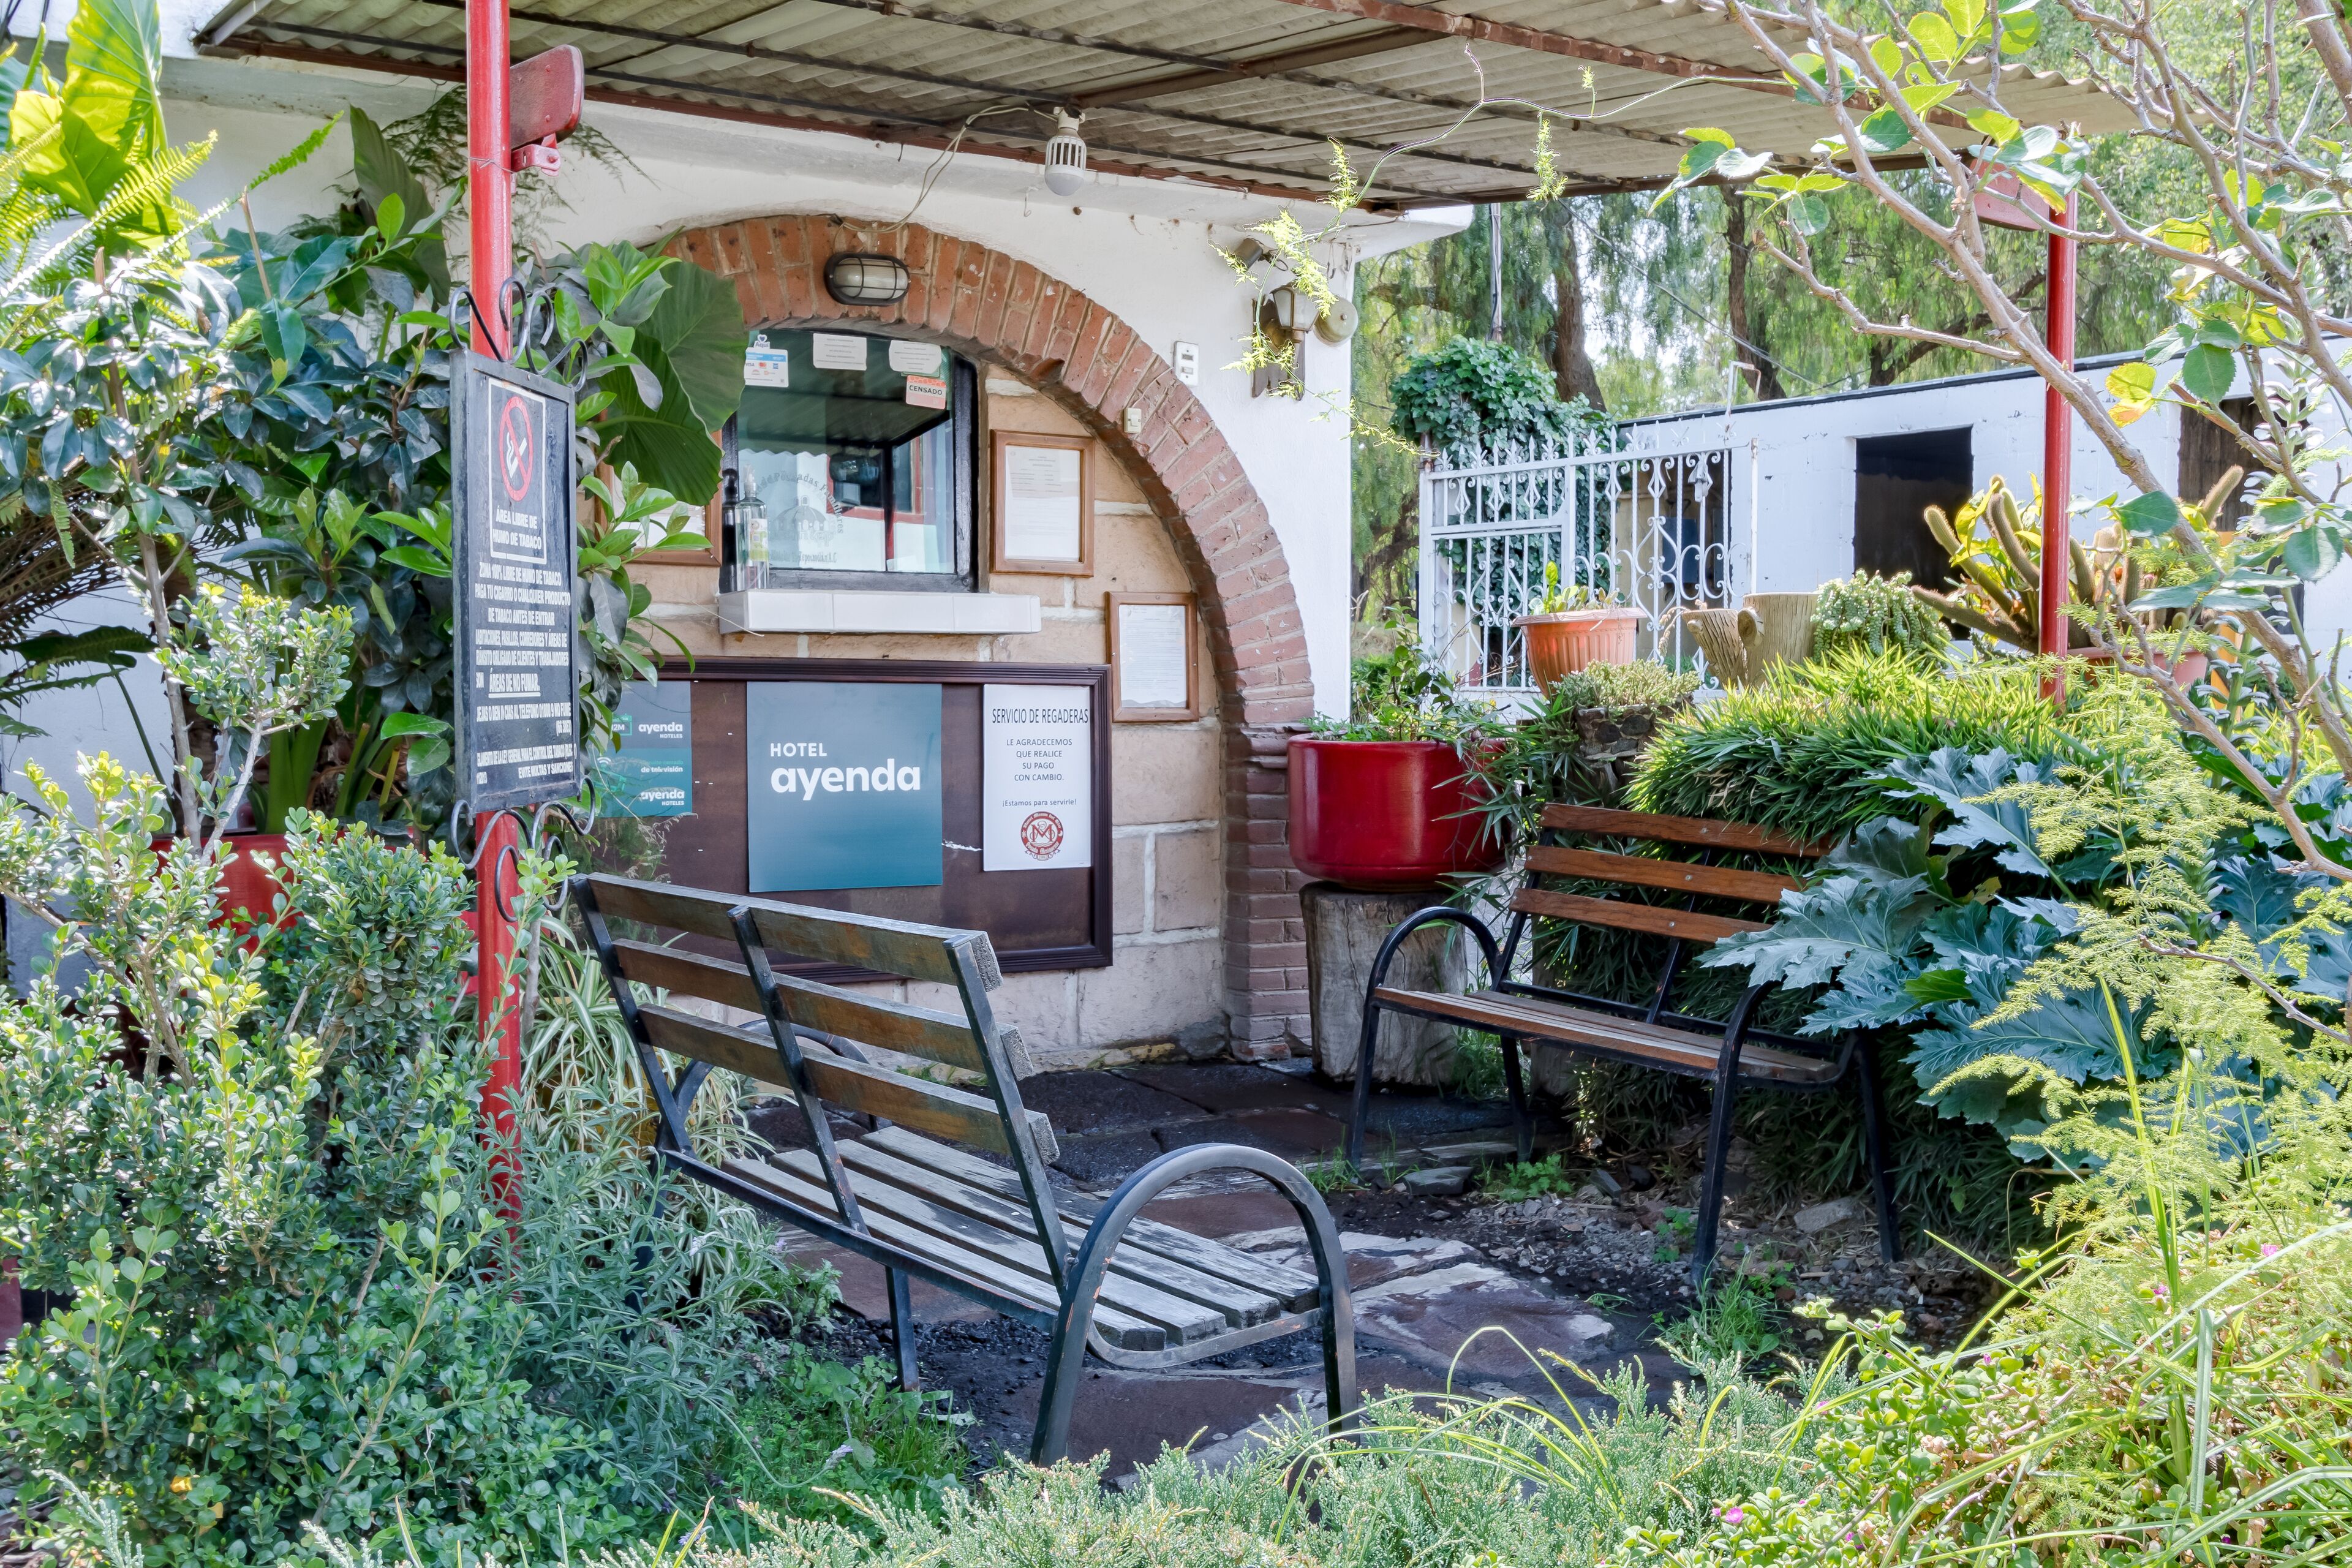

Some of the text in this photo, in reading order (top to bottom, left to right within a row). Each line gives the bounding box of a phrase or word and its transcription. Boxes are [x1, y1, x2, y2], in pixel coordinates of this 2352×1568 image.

[909, 385, 943, 395] CENSADO
[496, 505, 538, 529] ÁREA LIBRE DE
[492, 529, 542, 549] HUMO DE TABACO
[479, 562, 562, 586] ZONA 100% LIBRE DE HUMO DE TABACO
[487, 584, 493, 599] TU
[494, 586, 513, 601] CIGARRO
[513, 587, 518, 601] O
[518, 588, 544, 604] CUALQUIER
[545, 590, 571, 606] PRODUCTO
[488, 608, 555, 626] DE TABACO ANTES DE ENTRAR
[489, 668, 505, 692] ÁREAS
[506, 674, 513, 692] DE
[513, 674, 520, 692] NO
[521, 674, 540, 692] FUMAR.
[992, 709, 1088, 723] SERVICIO DE REGADERAS
[638, 722, 683, 734] ayenda
[770, 742, 827, 757] HOTEL
[518, 761, 574, 778] EVITE MULTAS Y SANCIONES
[771, 758, 921, 801] ayenda
[640, 790, 685, 801] ayenda
